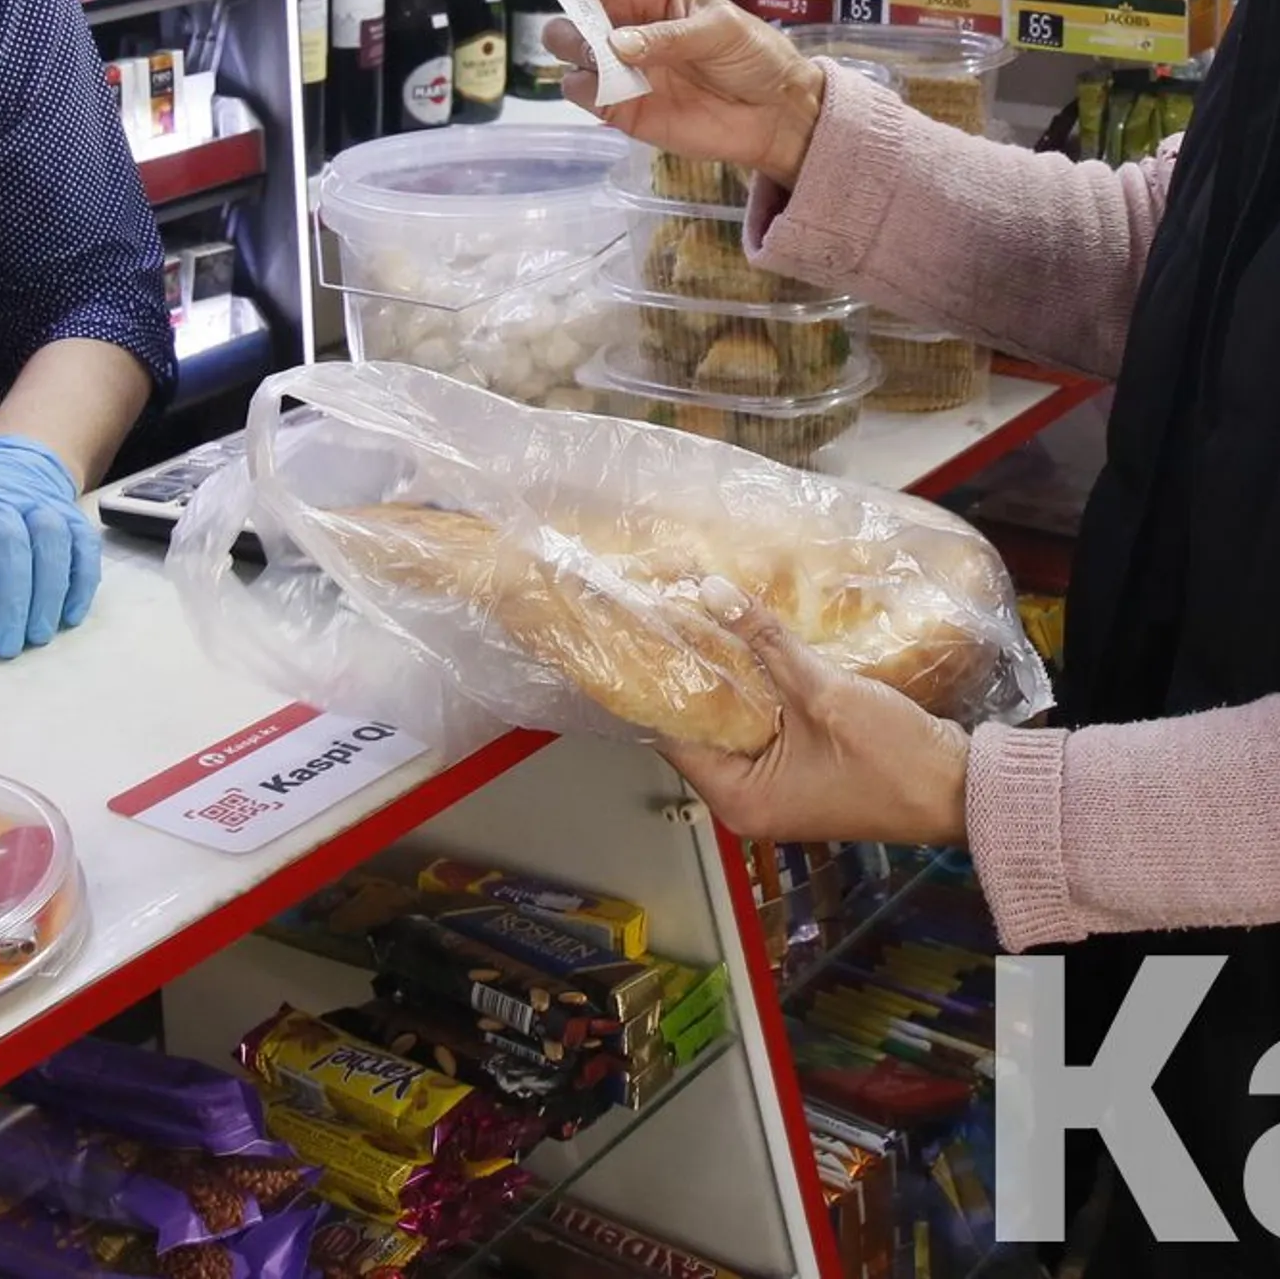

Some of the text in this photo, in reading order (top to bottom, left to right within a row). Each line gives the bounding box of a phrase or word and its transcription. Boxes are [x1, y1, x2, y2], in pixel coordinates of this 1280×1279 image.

[1104, 12, 1151, 28] JACOBS
[259, 739, 363, 795] Kaspi
[495, 911, 600, 960] ROSHEN
